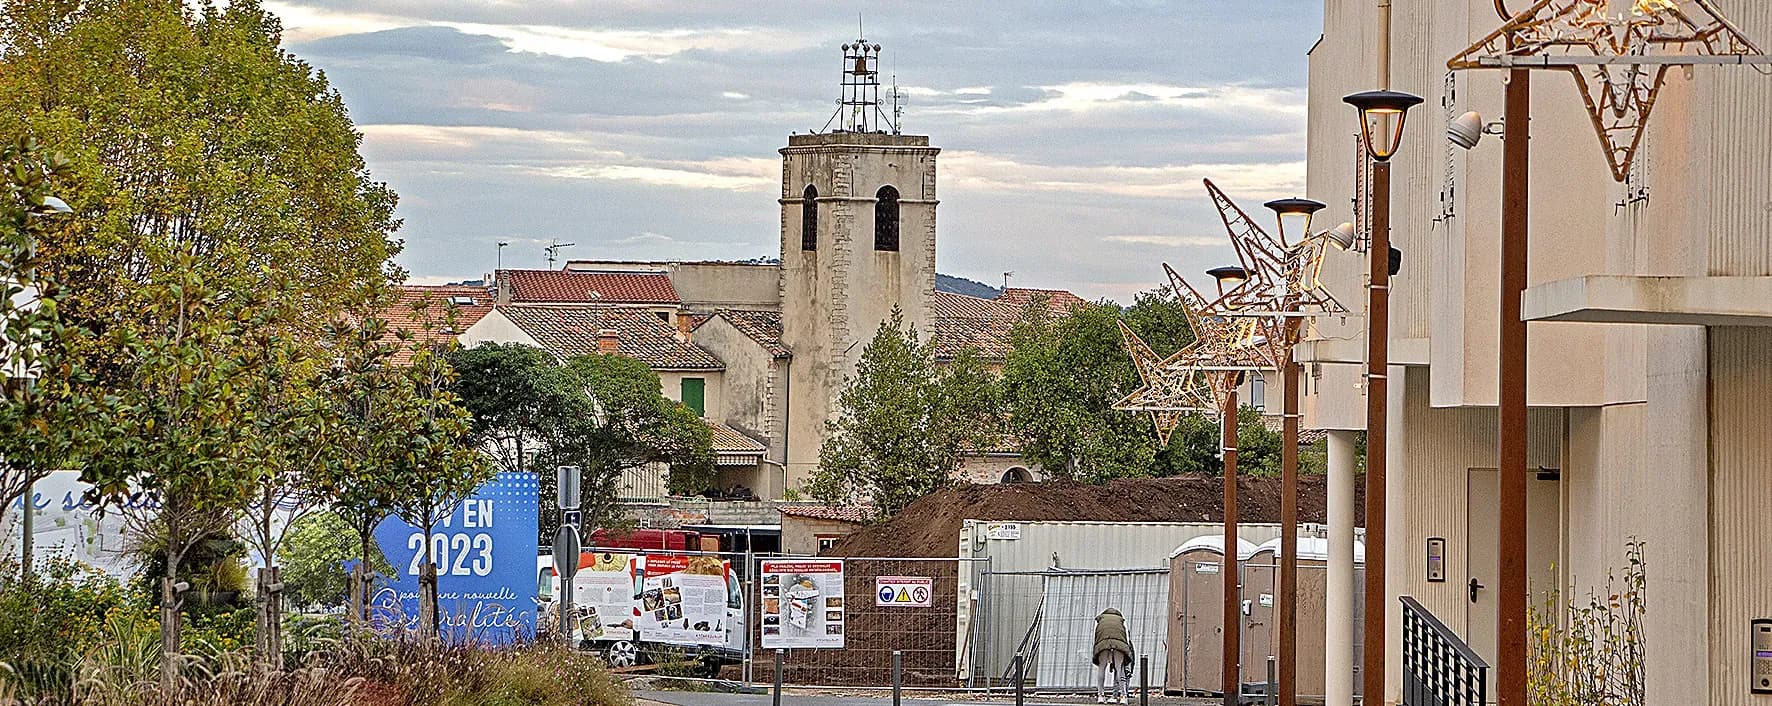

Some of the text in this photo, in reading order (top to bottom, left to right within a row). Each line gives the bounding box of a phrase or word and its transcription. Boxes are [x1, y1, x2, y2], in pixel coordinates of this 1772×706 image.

[463, 499, 493, 527] EN
[408, 532, 493, 576] 2023
[399, 591, 420, 602] pou
[463, 586, 518, 600] nouvelle
